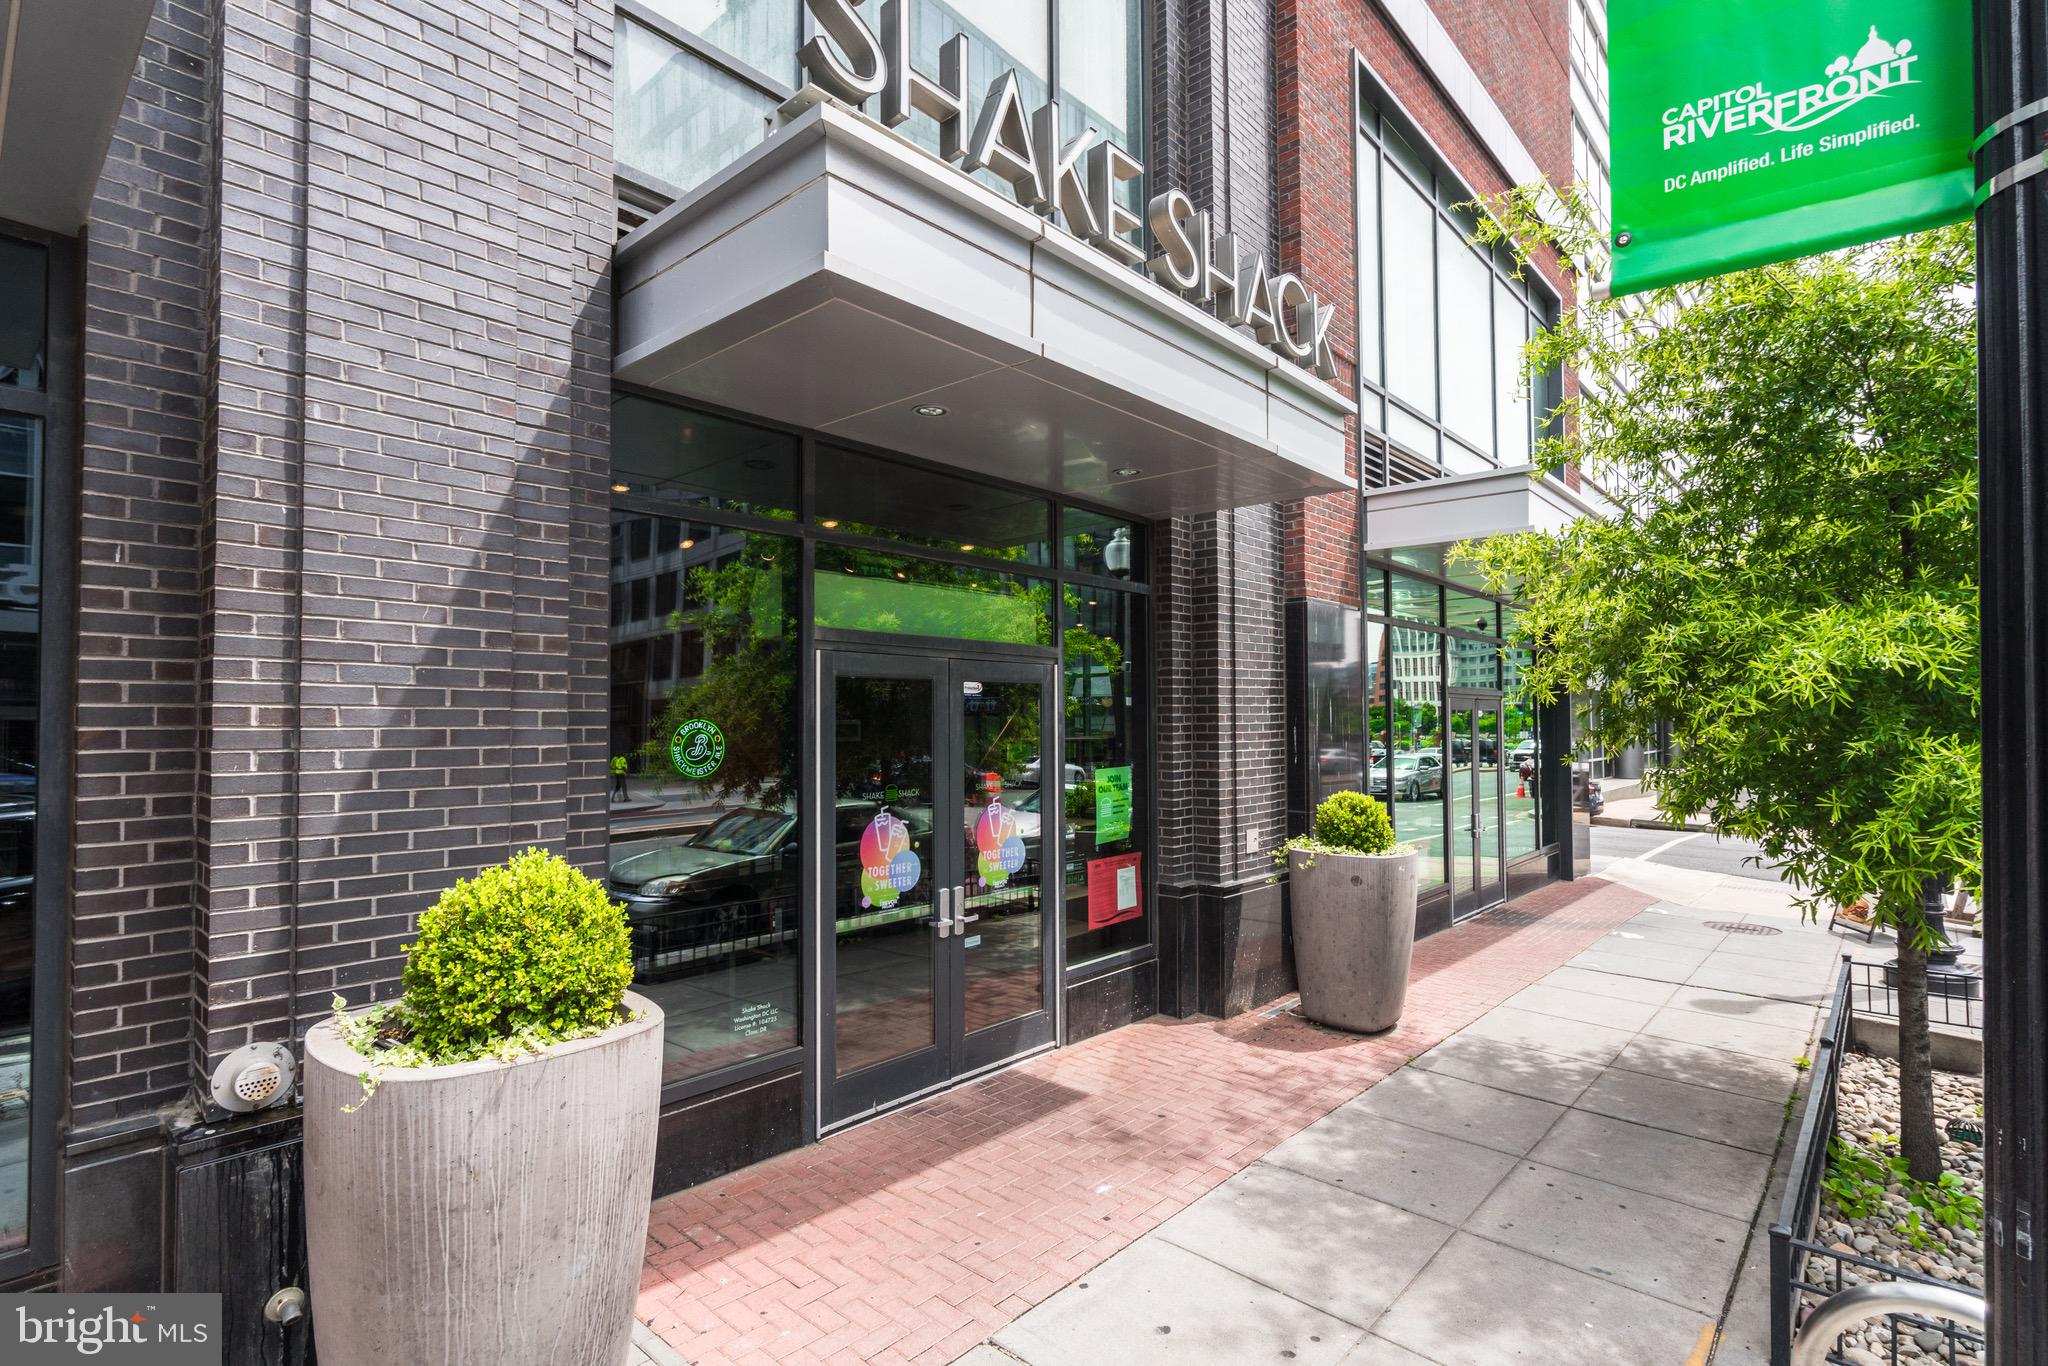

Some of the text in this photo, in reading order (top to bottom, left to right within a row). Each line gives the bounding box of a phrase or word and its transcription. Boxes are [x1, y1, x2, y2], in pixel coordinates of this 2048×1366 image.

[1661, 81, 1771, 126] CAPITOL
[1663, 55, 1921, 151] RIVERFRONT
[1664, 113, 1920, 193] DC Amplified. Life Simplified.
[797, 0, 1338, 380] SHAKE SHACK
[680, 722, 716, 736] BROOKLYN
[673, 746, 717, 775] SHACKMEISTER
[1107, 774, 1122, 783] JOIN
[862, 788, 920, 801] SHAKE SHACK
[983, 846, 1019, 860] TOGETHER
[868, 862, 913, 878] TOGETHER
[988, 859, 1019, 873] SWEETER
[875, 876, 913, 892] SWEETER
